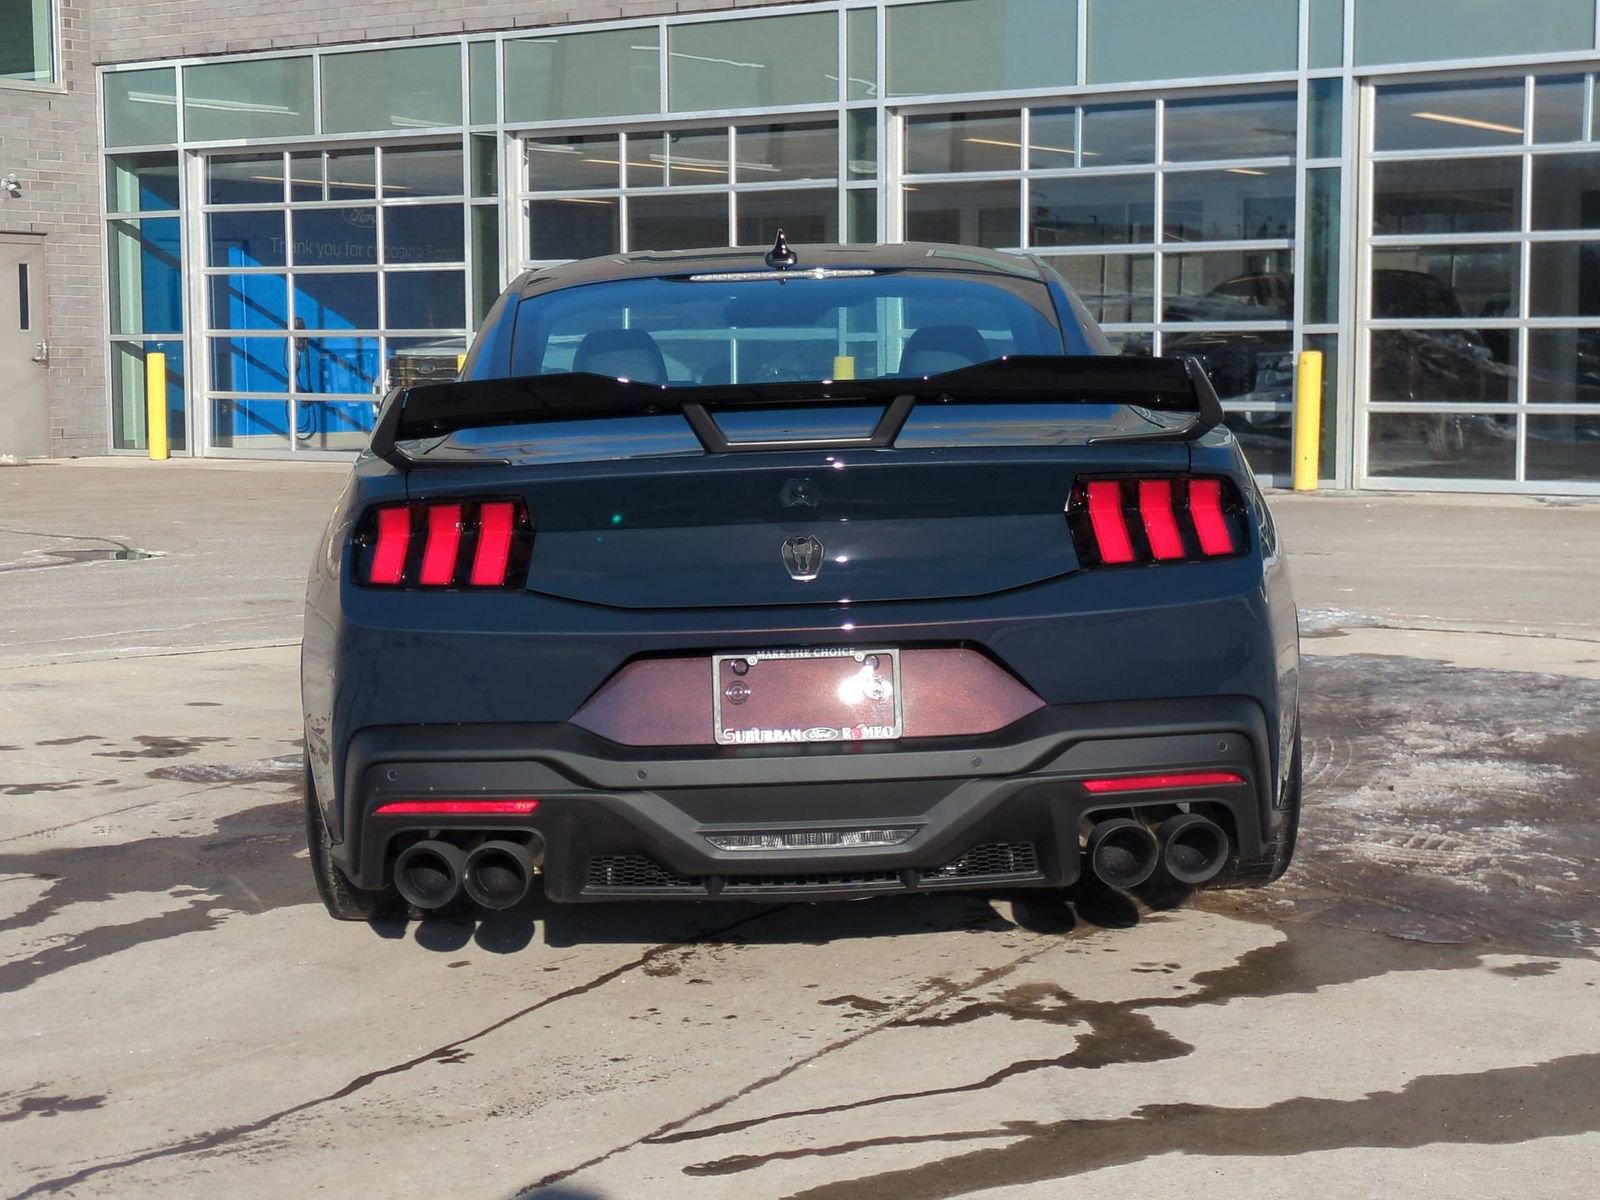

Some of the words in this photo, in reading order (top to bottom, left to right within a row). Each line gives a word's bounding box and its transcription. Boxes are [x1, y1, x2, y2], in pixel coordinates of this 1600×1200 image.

[317, 242, 342, 258] you
[345, 241, 363, 257] for
[366, 242, 424, 261] coosing
[756, 650, 787, 659] MAKE
[788, 649, 811, 658] THE
[813, 647, 856, 657] CHOICE
[723, 727, 801, 743] SUBURBAN
